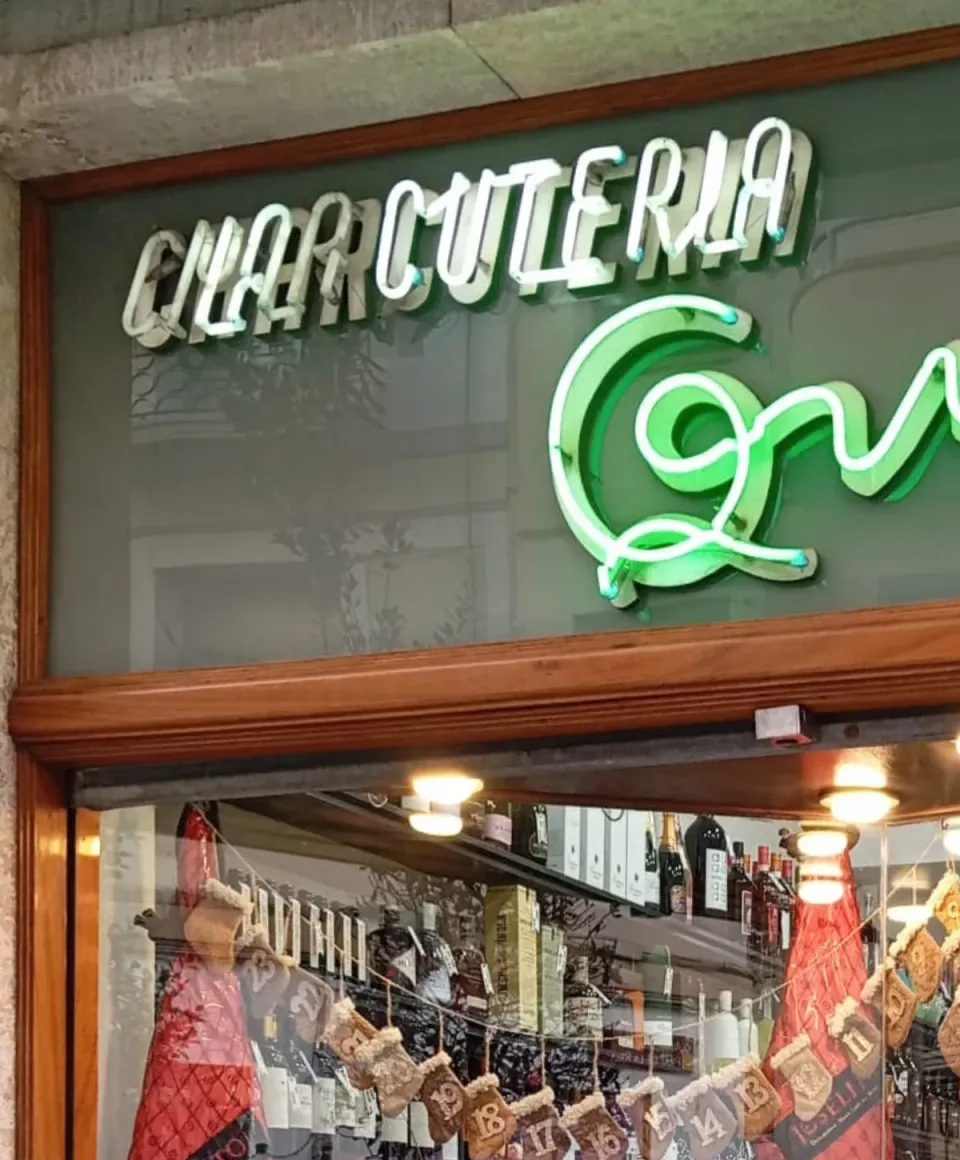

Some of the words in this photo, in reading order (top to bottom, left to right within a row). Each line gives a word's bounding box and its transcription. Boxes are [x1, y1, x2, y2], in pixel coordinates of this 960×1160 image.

[734, 1075, 769, 1113] 13
[471, 1103, 505, 1140] 18
[526, 1119, 556, 1156] 17
[690, 1107, 727, 1147] 14
